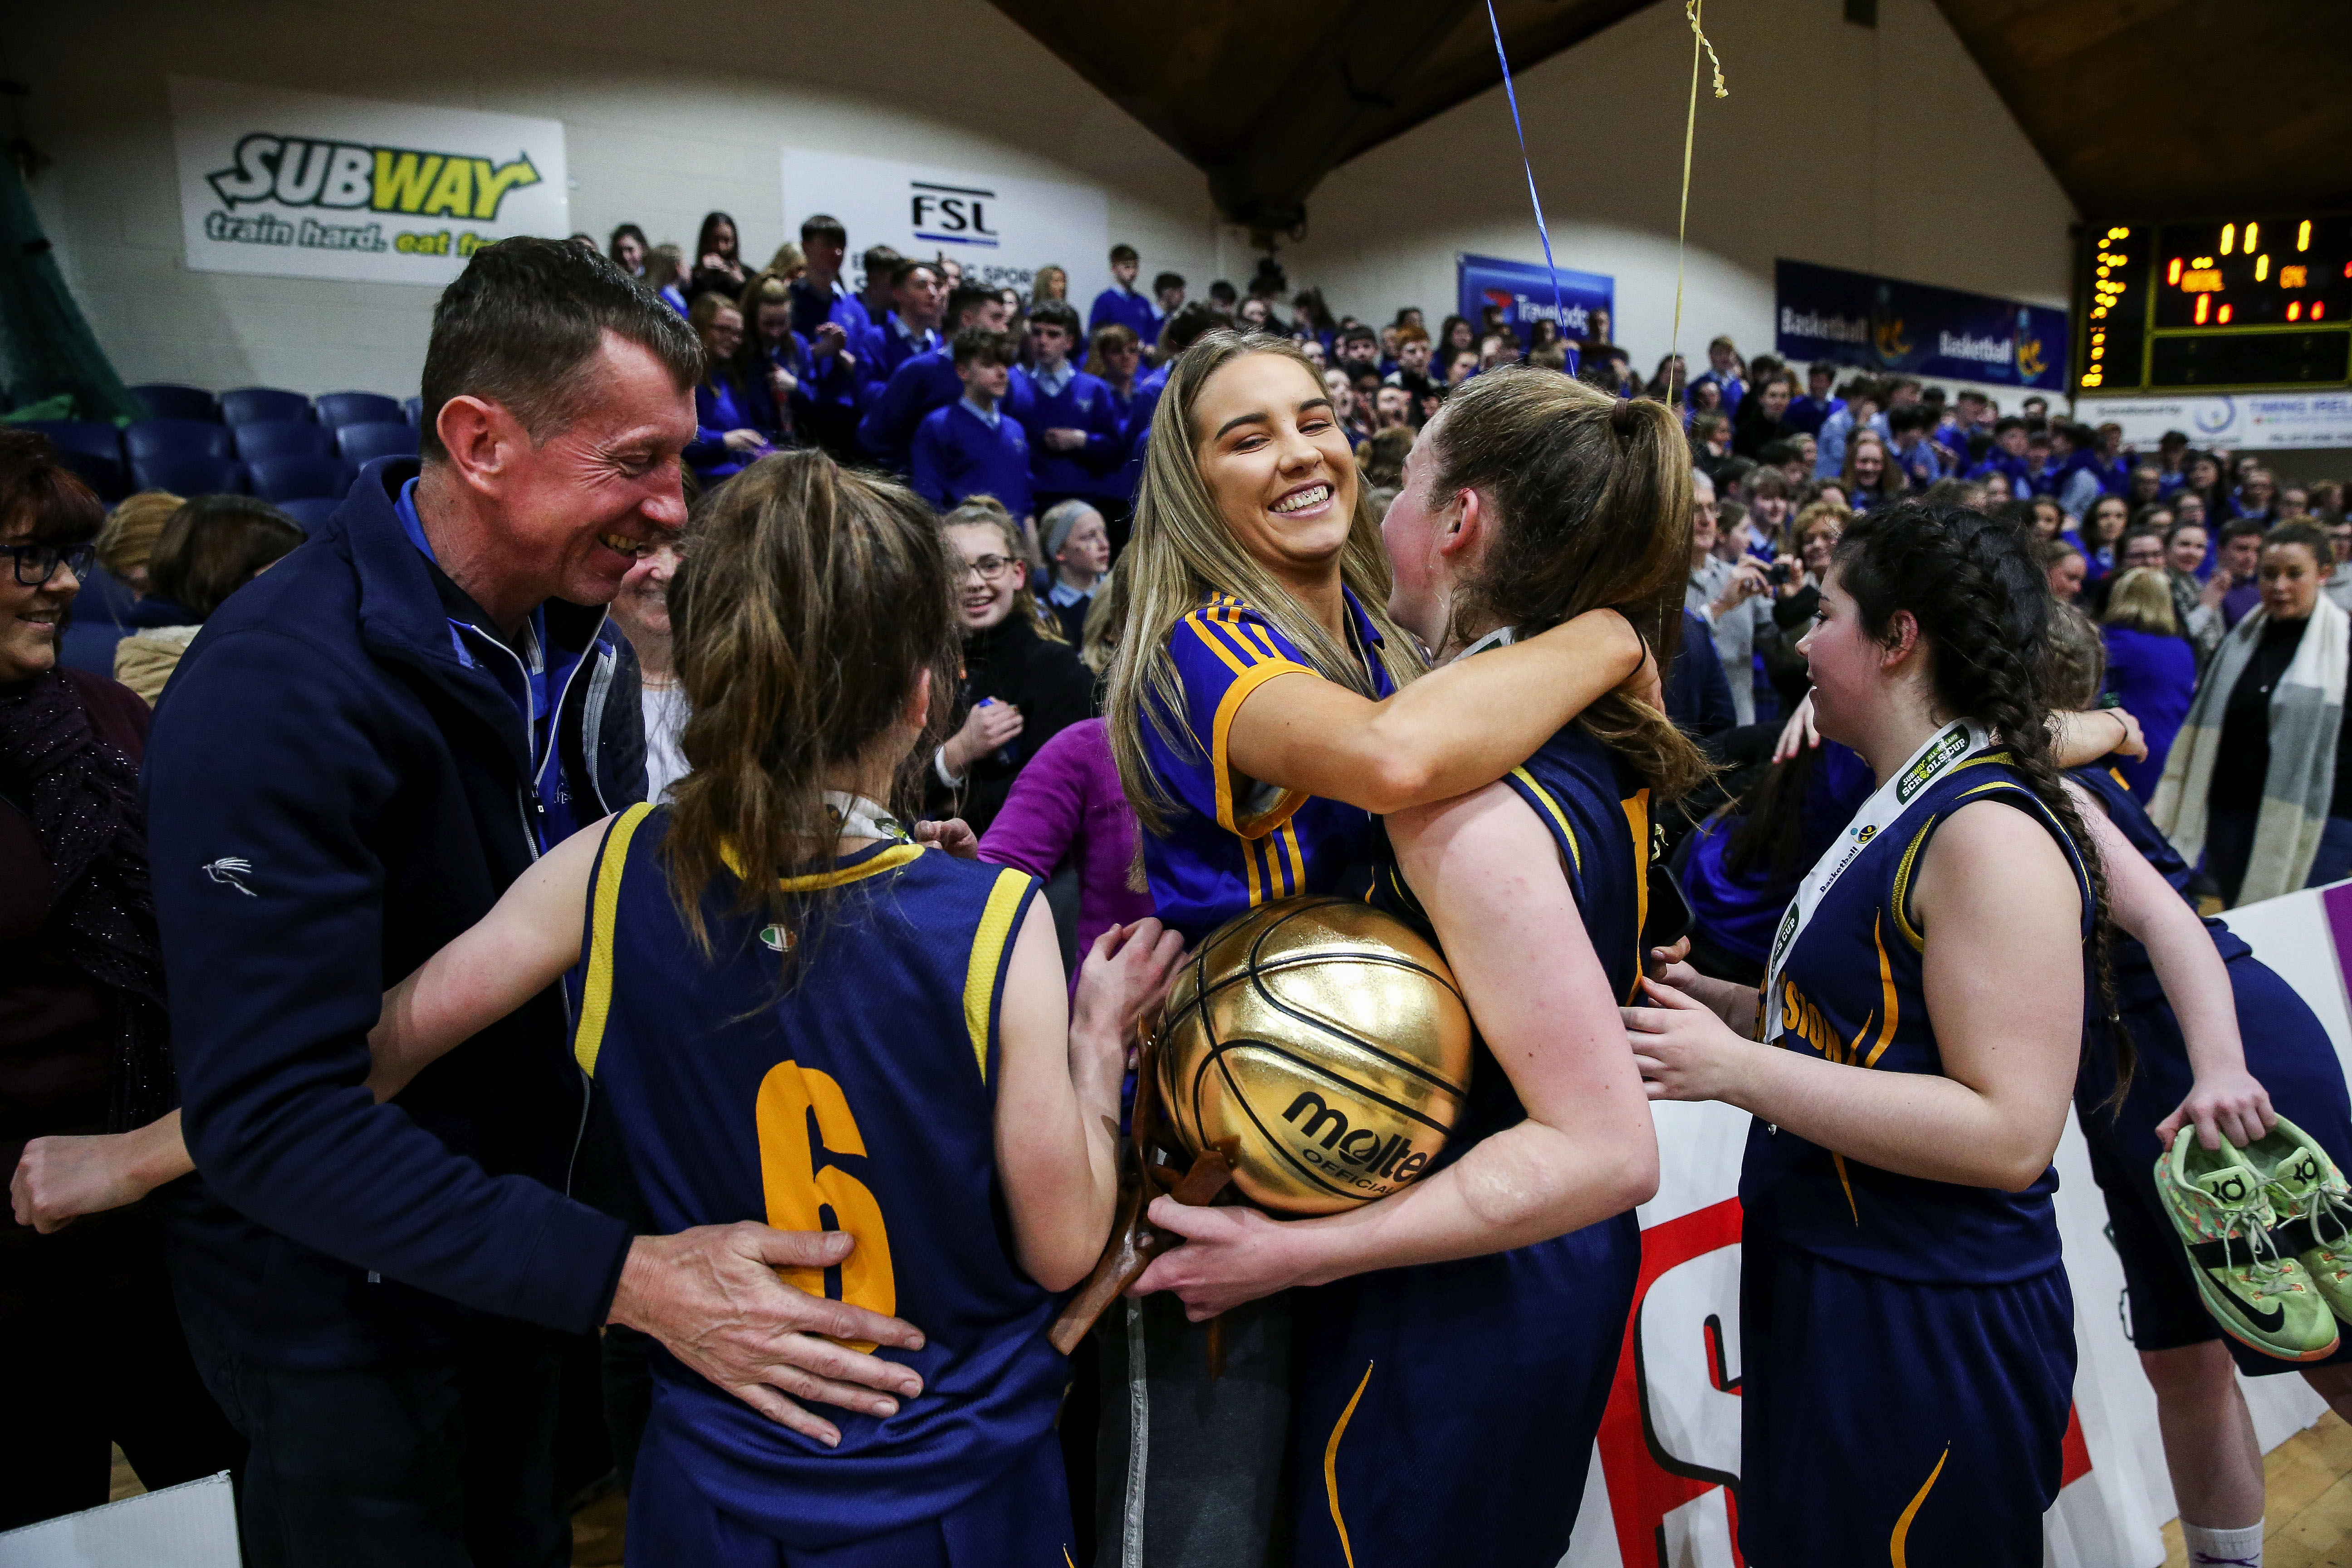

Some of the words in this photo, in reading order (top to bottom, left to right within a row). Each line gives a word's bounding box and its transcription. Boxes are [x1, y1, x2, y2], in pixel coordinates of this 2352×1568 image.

[206, 132, 541, 221] SUBWAY
[205, 210, 293, 246] train
[298, 216, 388, 253] hard.
[394, 230, 451, 256] eat
[911, 195, 999, 236] FSL
[983, 265, 1031, 283] SPOR
[1939, 330, 2013, 364] Basketball
[1946, 738, 1965, 756] CUP
[1903, 759, 1926, 786] SUBWAY
[1819, 846, 1858, 892] Basketball
[1782, 918, 1795, 941] CUP
[1282, 1091, 1428, 1182] molte
[756, 1060, 896, 1354] 6
